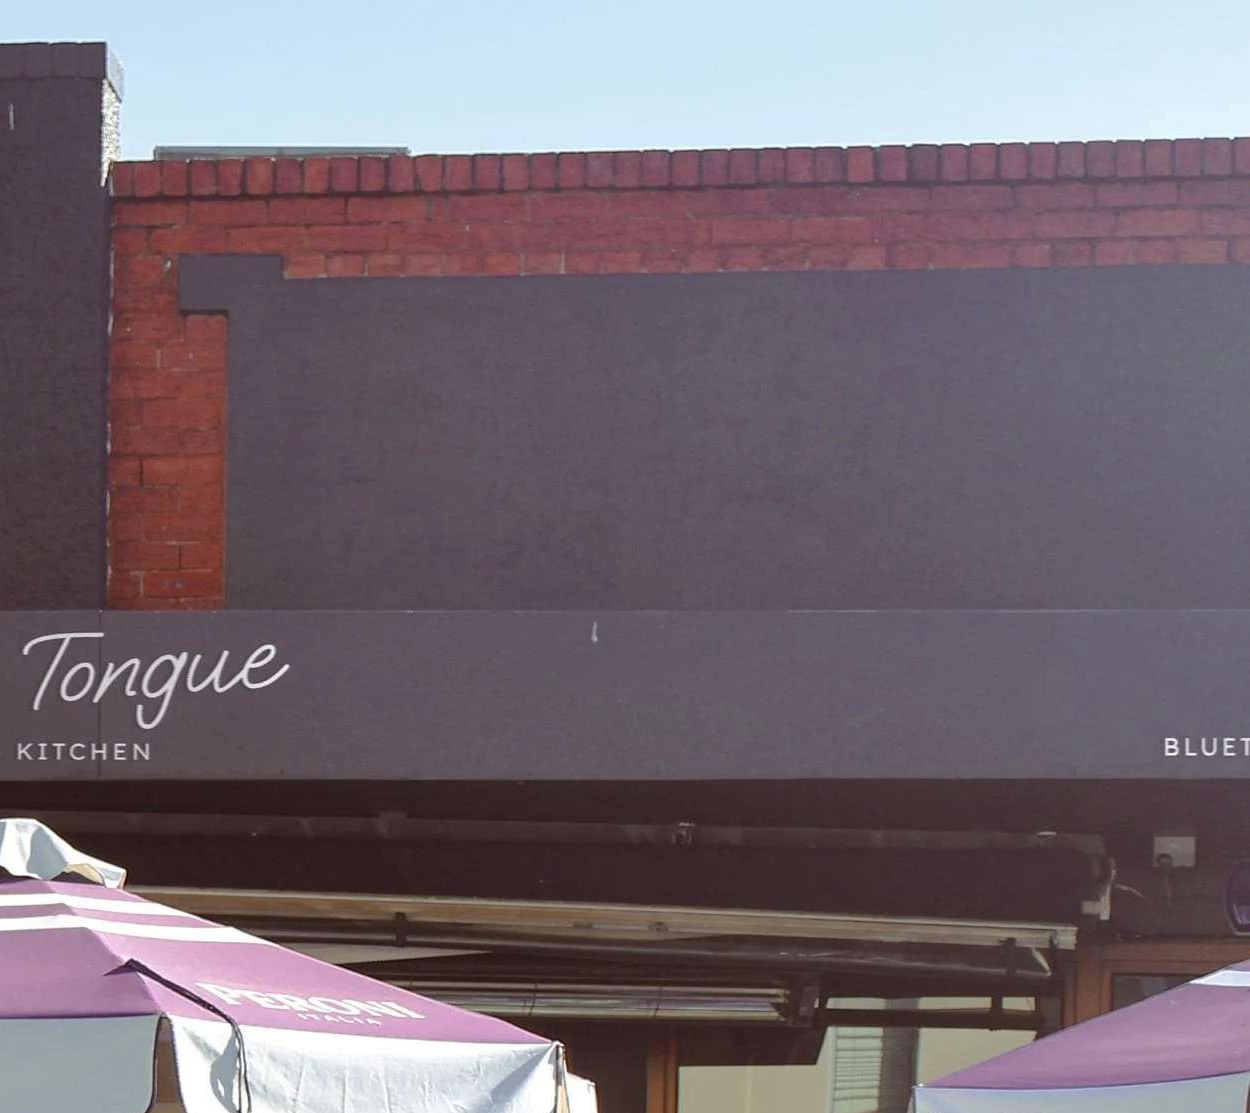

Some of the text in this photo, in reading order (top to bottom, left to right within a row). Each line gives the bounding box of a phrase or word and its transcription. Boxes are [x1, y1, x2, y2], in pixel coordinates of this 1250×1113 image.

[22, 631, 291, 730] Tongue
[17, 742, 151, 761] KITCHEN
[194, 982, 426, 1019] PERONI
[297, 1012, 382, 1026] ITALIA
